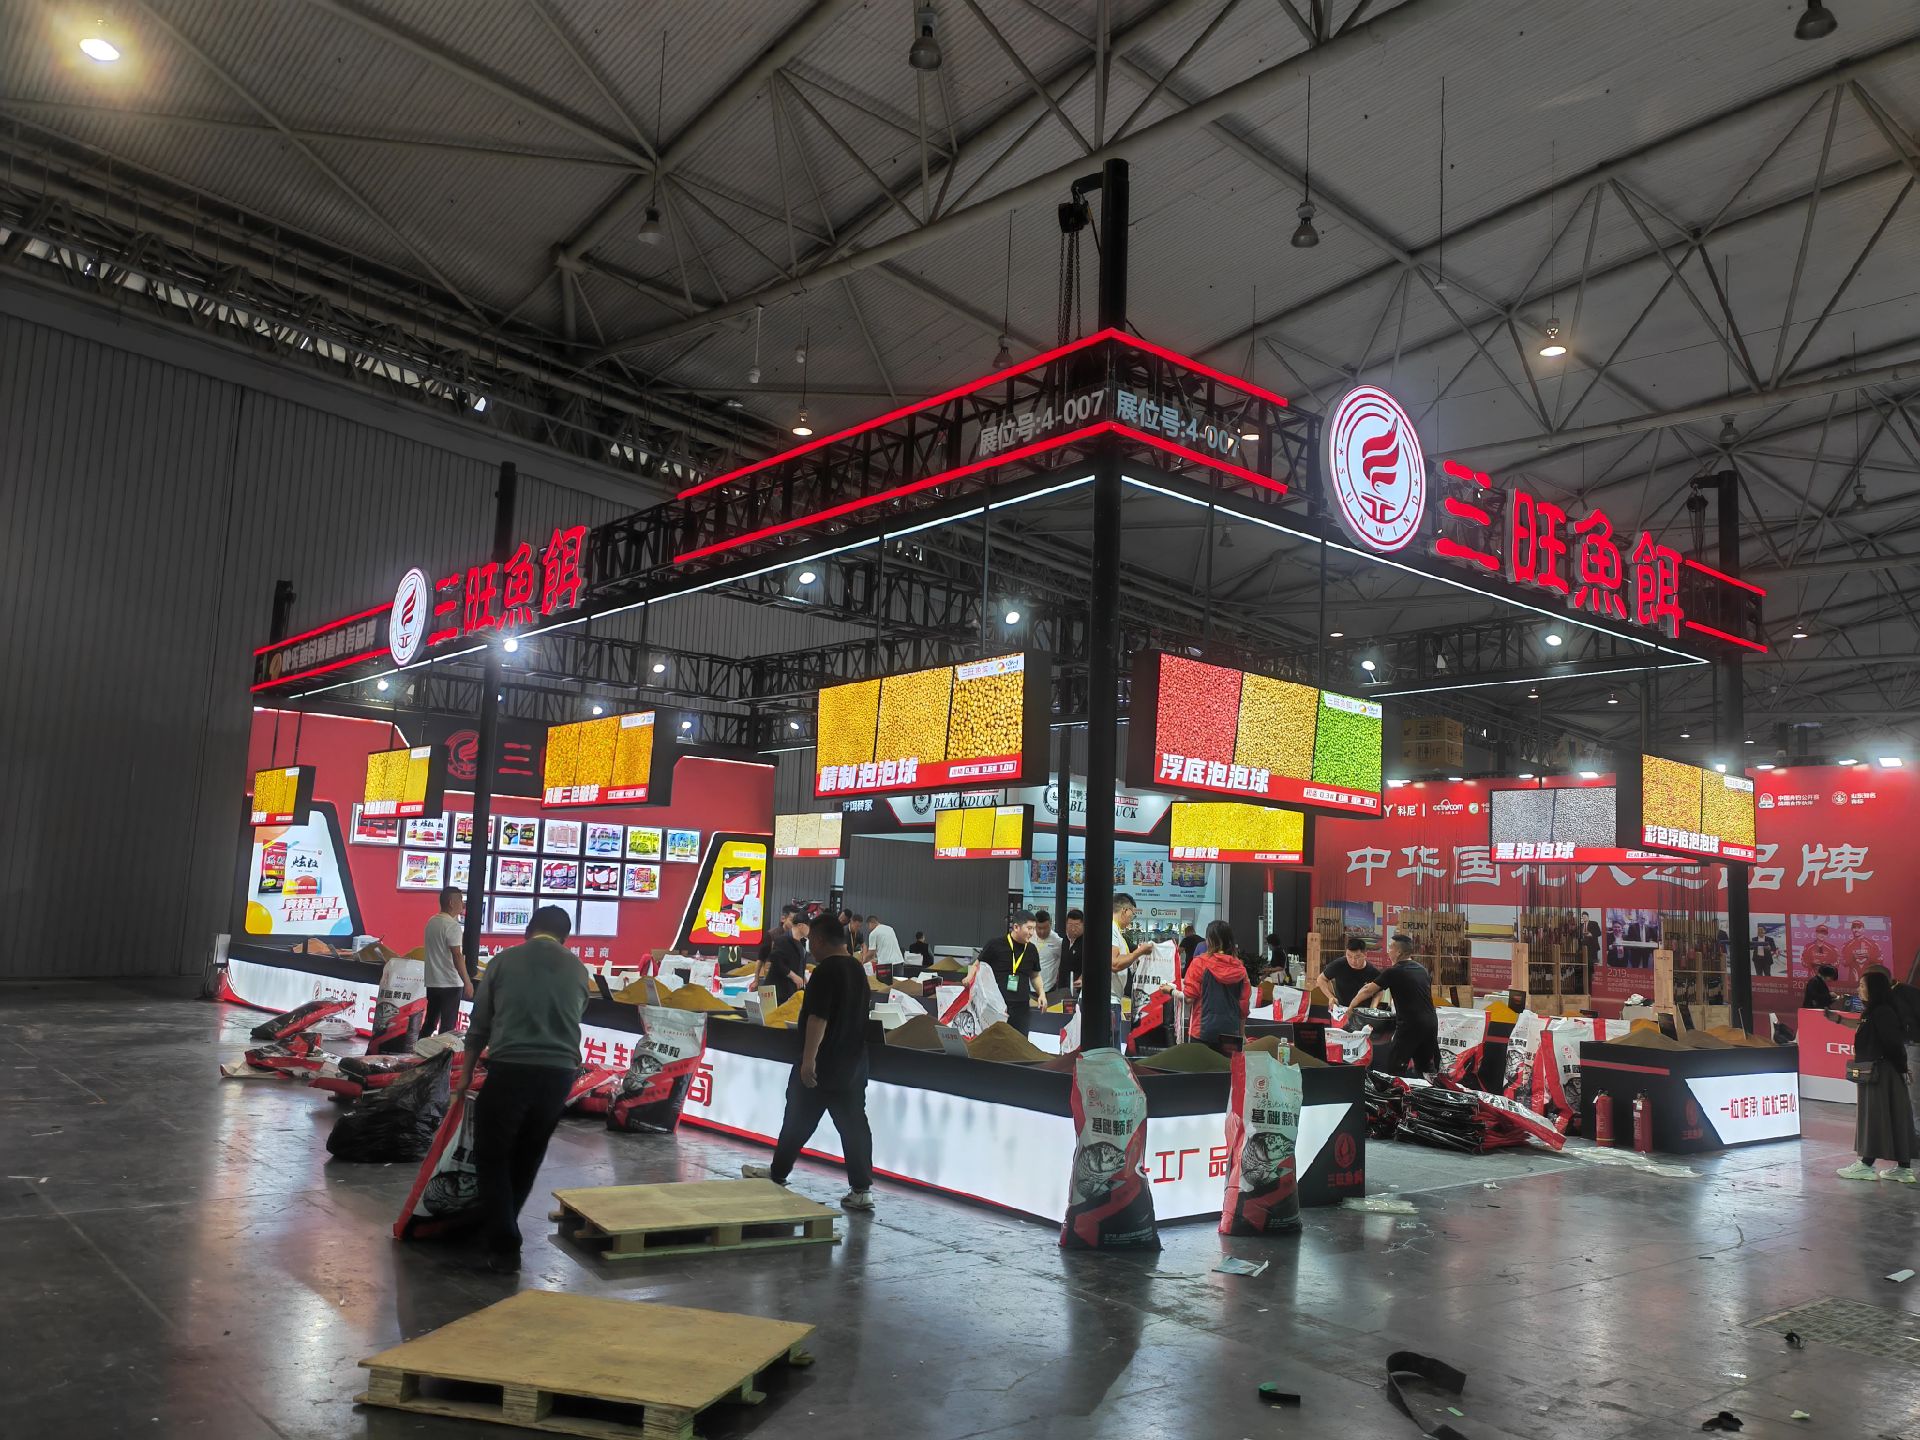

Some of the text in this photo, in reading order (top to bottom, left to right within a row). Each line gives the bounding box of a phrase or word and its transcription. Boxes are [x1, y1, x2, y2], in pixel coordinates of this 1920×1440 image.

[818, 757, 919, 791] 精制泡泡球
[1159, 753, 1269, 793] 浮底泡泡球
[934, 795, 999, 809] BLACKDUCK
[1496, 842, 1576, 859] 黑泡泡球
